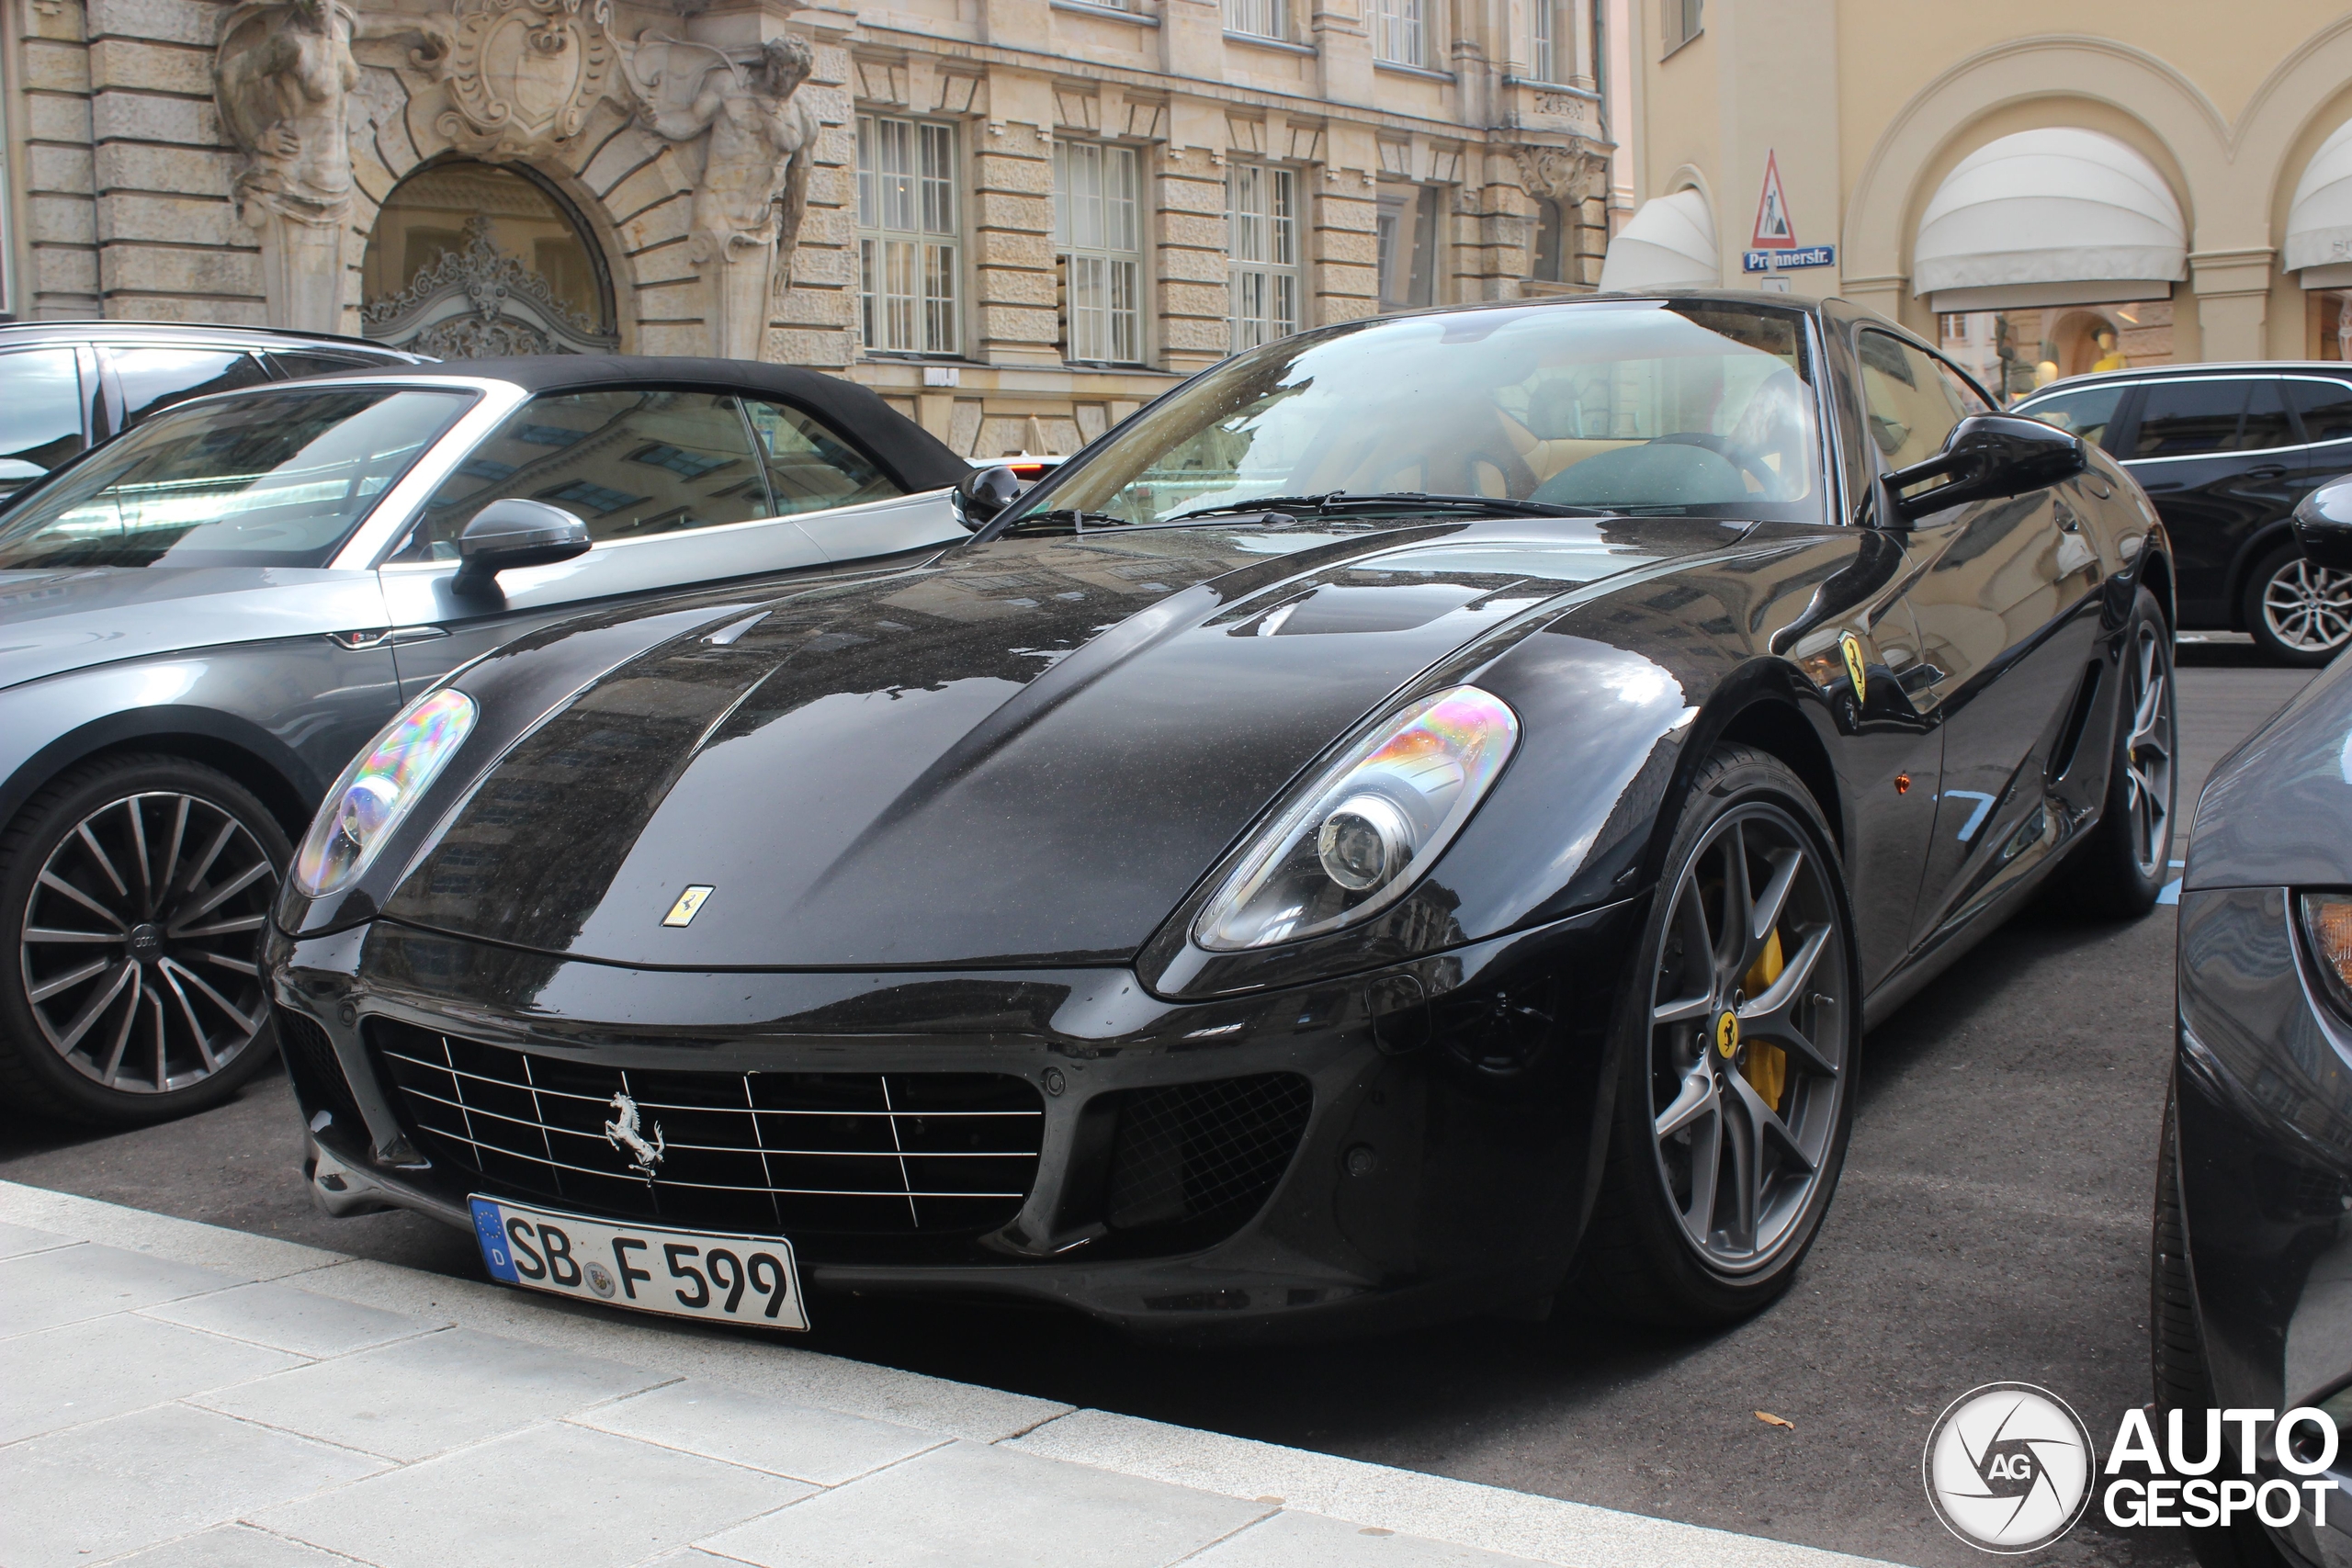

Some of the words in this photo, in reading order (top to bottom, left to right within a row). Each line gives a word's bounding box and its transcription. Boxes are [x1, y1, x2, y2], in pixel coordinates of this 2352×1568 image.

[492, 1248, 505, 1266] D
[506, 1217, 582, 1287] SB
[612, 1236, 651, 1299] F
[663, 1243, 786, 1318] 599
